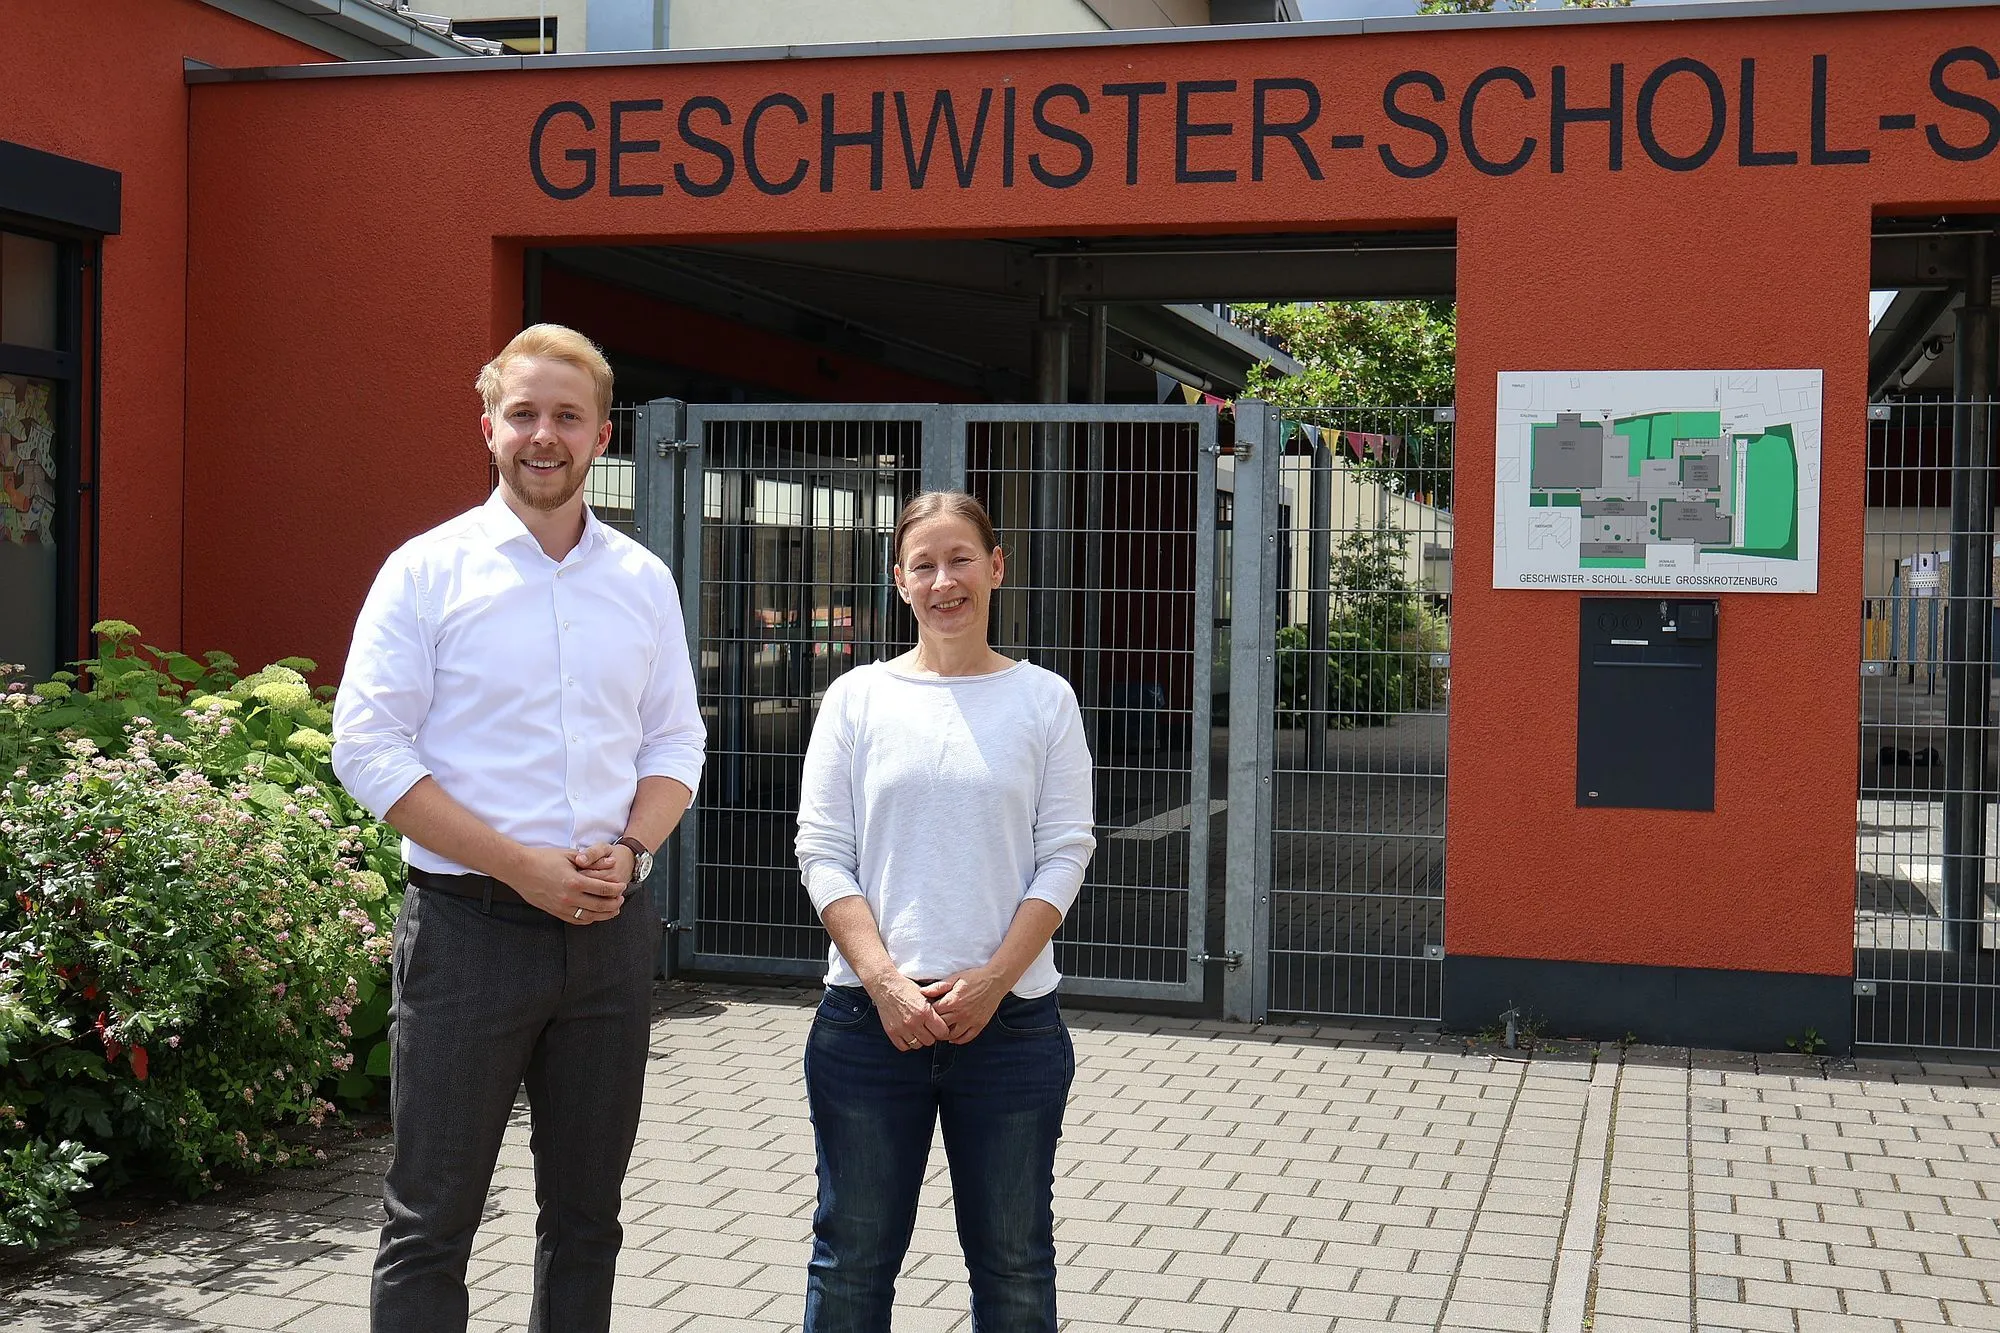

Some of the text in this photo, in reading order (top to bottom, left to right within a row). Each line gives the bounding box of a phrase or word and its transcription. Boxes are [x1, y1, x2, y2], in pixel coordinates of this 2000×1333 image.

[1519, 573, 1585, 584] GESCHWISTER
[1591, 574, 1627, 584] SCHOLL
[1634, 575, 1671, 585] SCHULE
[1675, 575, 1778, 586] GROSSKROTZENBURG
